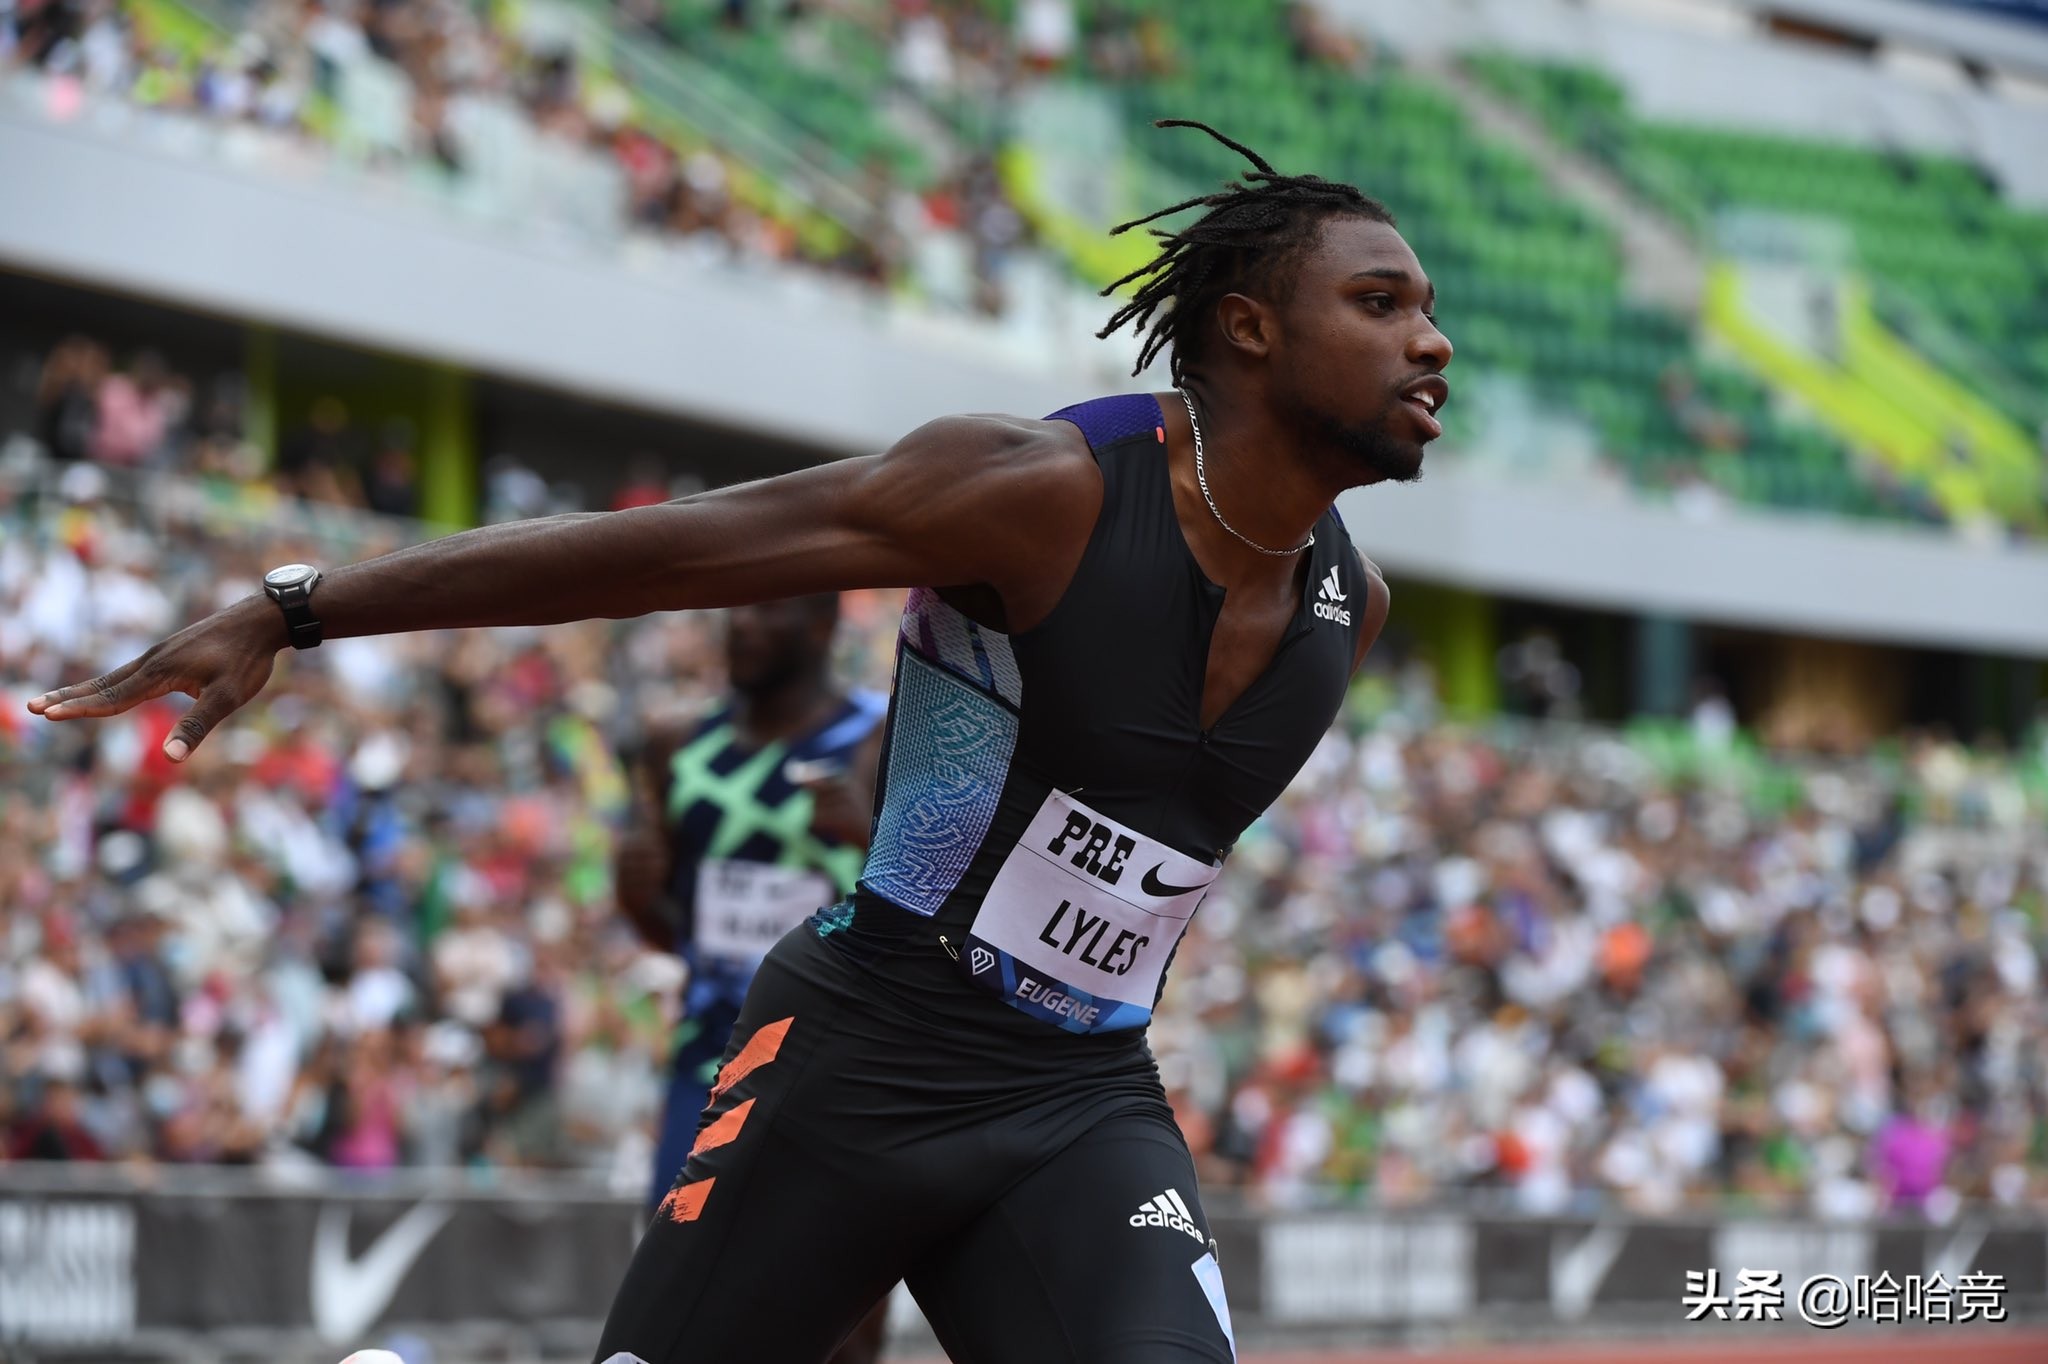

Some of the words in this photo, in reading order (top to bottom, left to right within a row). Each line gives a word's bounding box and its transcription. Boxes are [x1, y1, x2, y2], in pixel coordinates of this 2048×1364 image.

[1047, 809, 1136, 886] PRE
[1038, 899, 1149, 976] LYLES
[1015, 976, 1099, 1026] EUGENE
[1129, 1210, 1205, 1244] adidas
